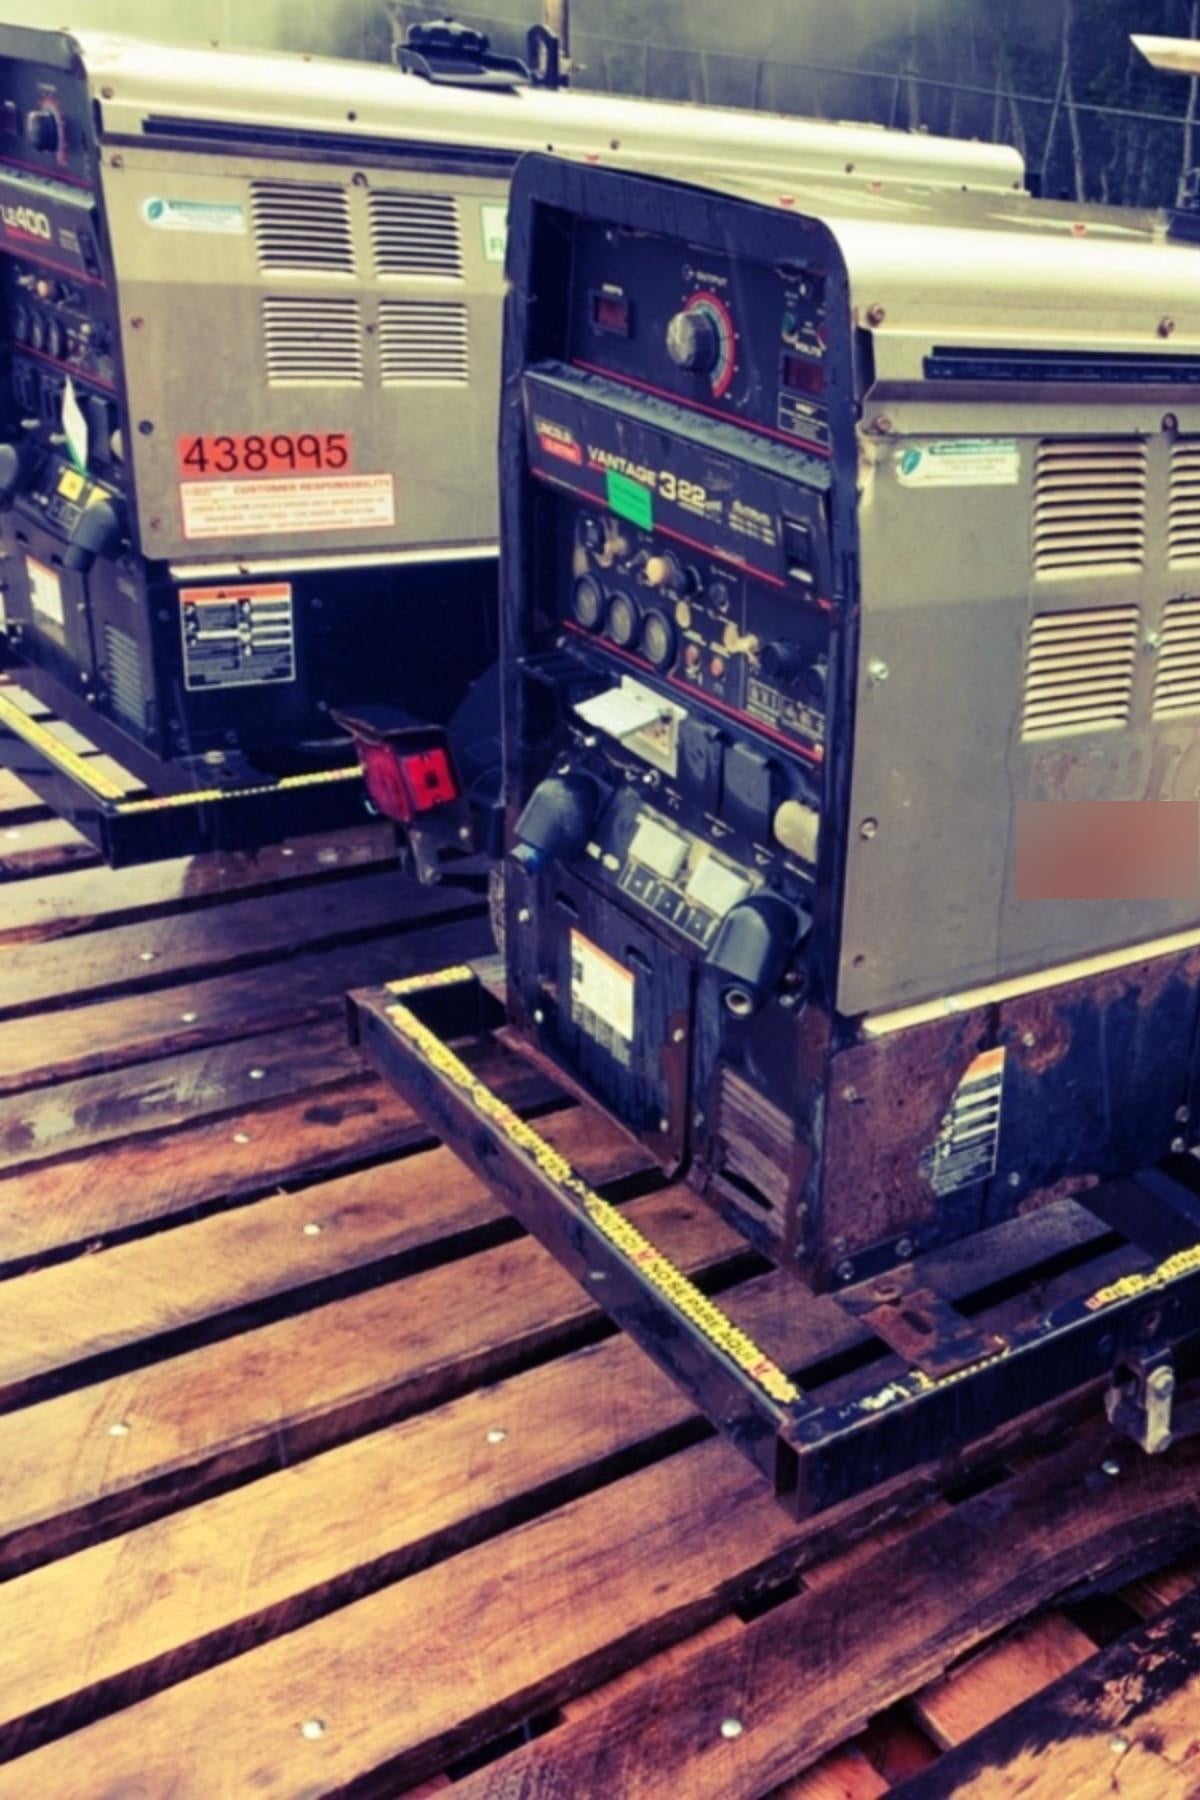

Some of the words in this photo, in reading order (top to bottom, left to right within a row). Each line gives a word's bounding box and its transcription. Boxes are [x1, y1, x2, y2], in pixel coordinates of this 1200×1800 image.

[183, 434, 348, 473] 438995
[586, 444, 656, 489] VANTAGE
[658, 470, 707, 507] 322
